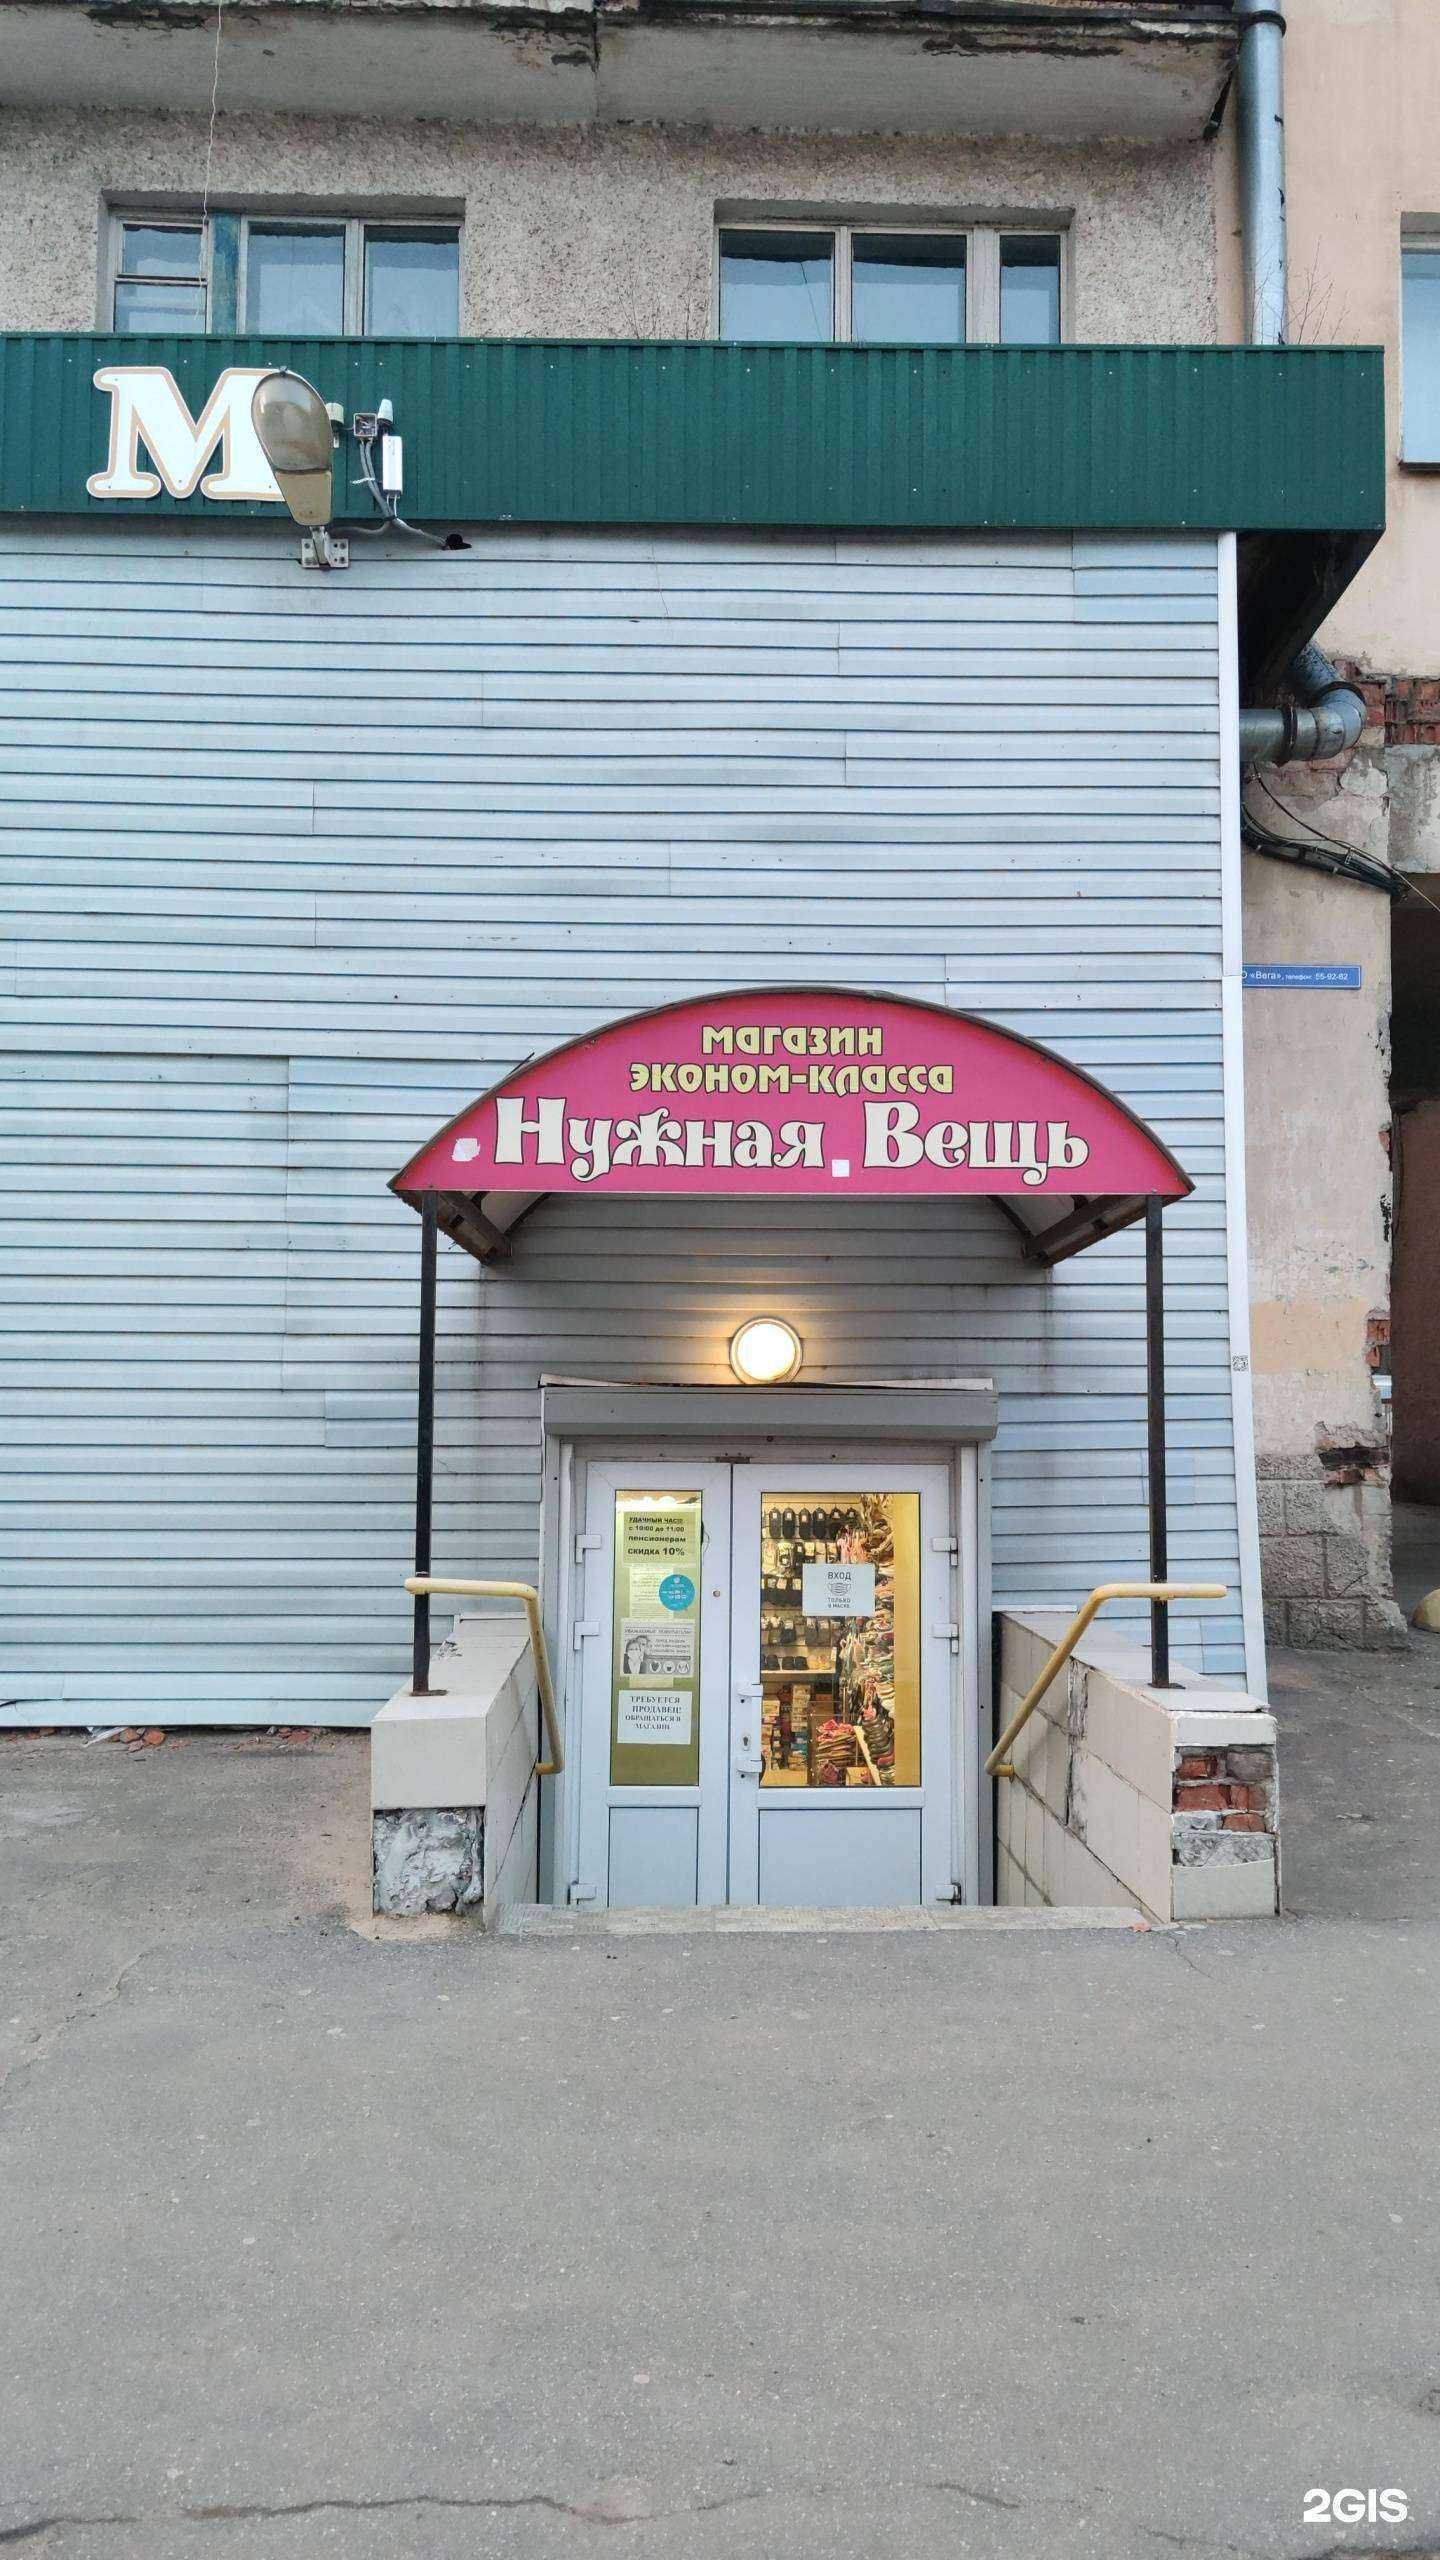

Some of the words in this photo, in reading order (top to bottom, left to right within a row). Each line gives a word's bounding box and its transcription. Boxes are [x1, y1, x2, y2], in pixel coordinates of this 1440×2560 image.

[494, 1095, 825, 1183] Нужная
[862, 1100, 1090, 1187] Вещь
[628, 1548, 660, 1556] СКИДКА
[662, 1547, 685, 1557] 10%
[827, 1571, 852, 1581] ВХОД
[630, 1695, 681, 1704] ТРЕБУЕТСЯ
[625, 1714, 675, 1722] ОБРАЩАТЬСЯ
